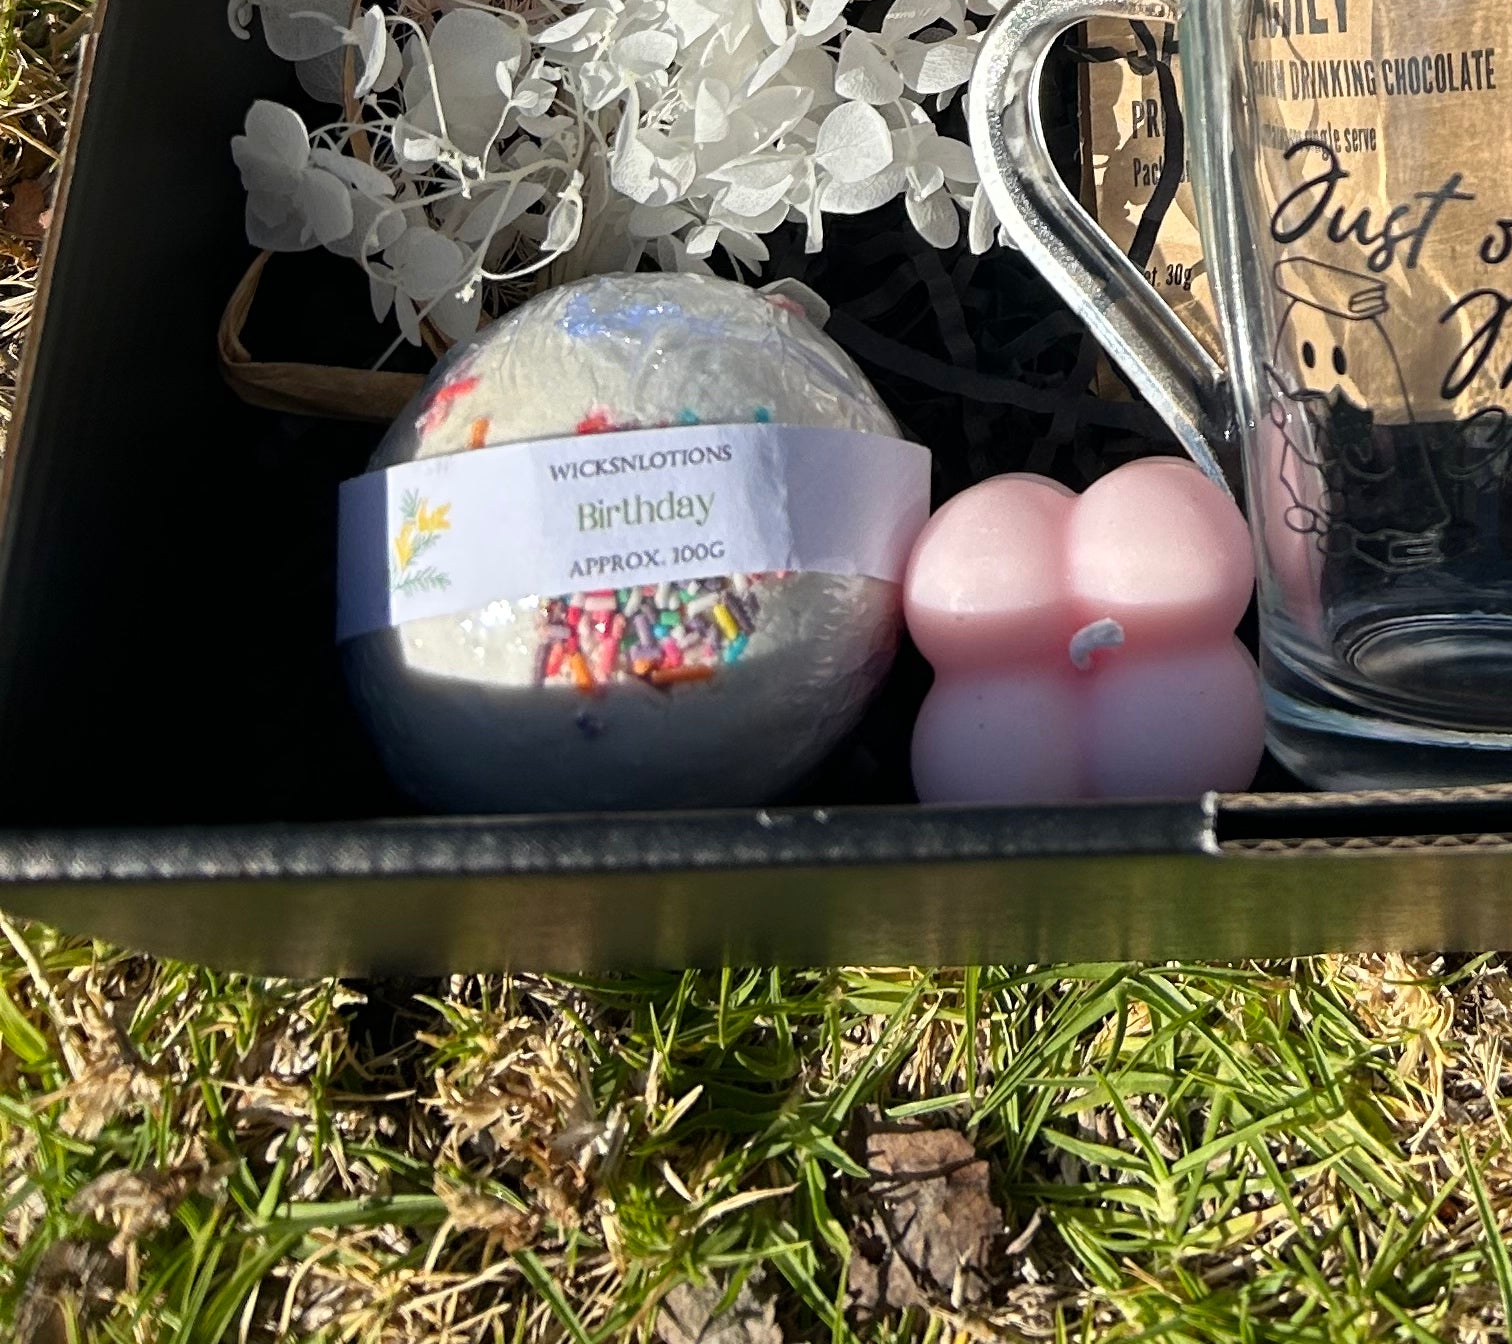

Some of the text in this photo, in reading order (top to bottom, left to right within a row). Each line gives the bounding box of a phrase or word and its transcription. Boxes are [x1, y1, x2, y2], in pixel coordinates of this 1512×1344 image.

[1289, 59, 1377, 101] DRINKING
[1382, 47, 1497, 96] CHOCOLATE
[1344, 127, 1377, 153] serve
[1270, 139, 1475, 272] Just
[1165, 262, 1192, 292] 30g
[548, 444, 733, 482] WICKSNLOTIONS
[577, 490, 715, 532] Birthday
[569, 541, 726, 579] APPROX. 100G
